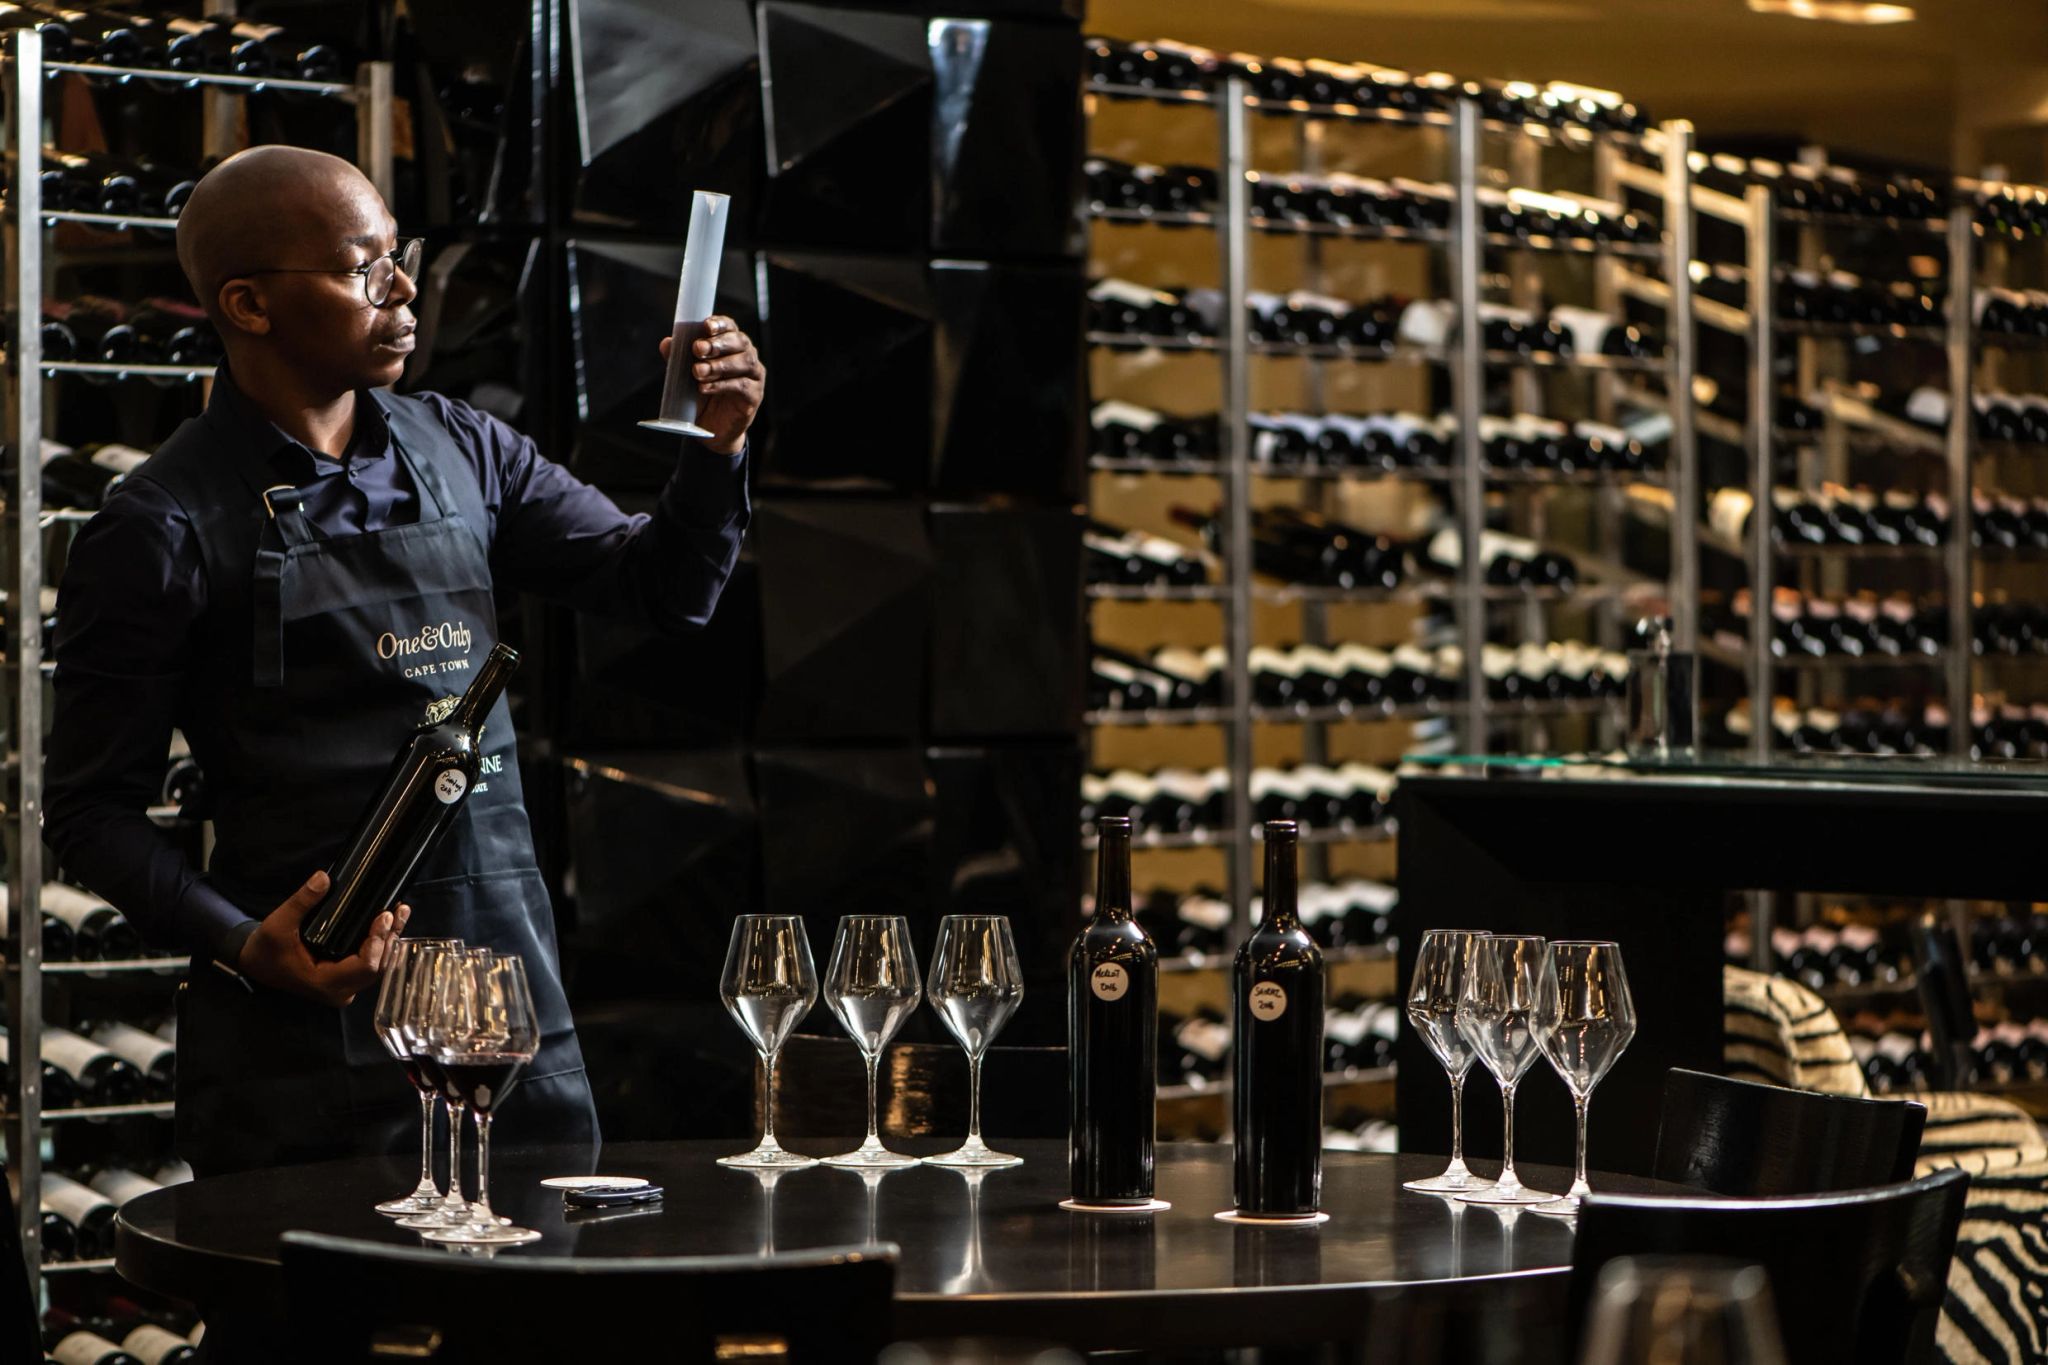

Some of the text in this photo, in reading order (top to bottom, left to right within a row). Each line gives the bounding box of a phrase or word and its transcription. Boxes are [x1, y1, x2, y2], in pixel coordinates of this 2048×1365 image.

[376, 621, 471, 660] One&Only
[404, 658, 470, 679] CAPE TOWN
